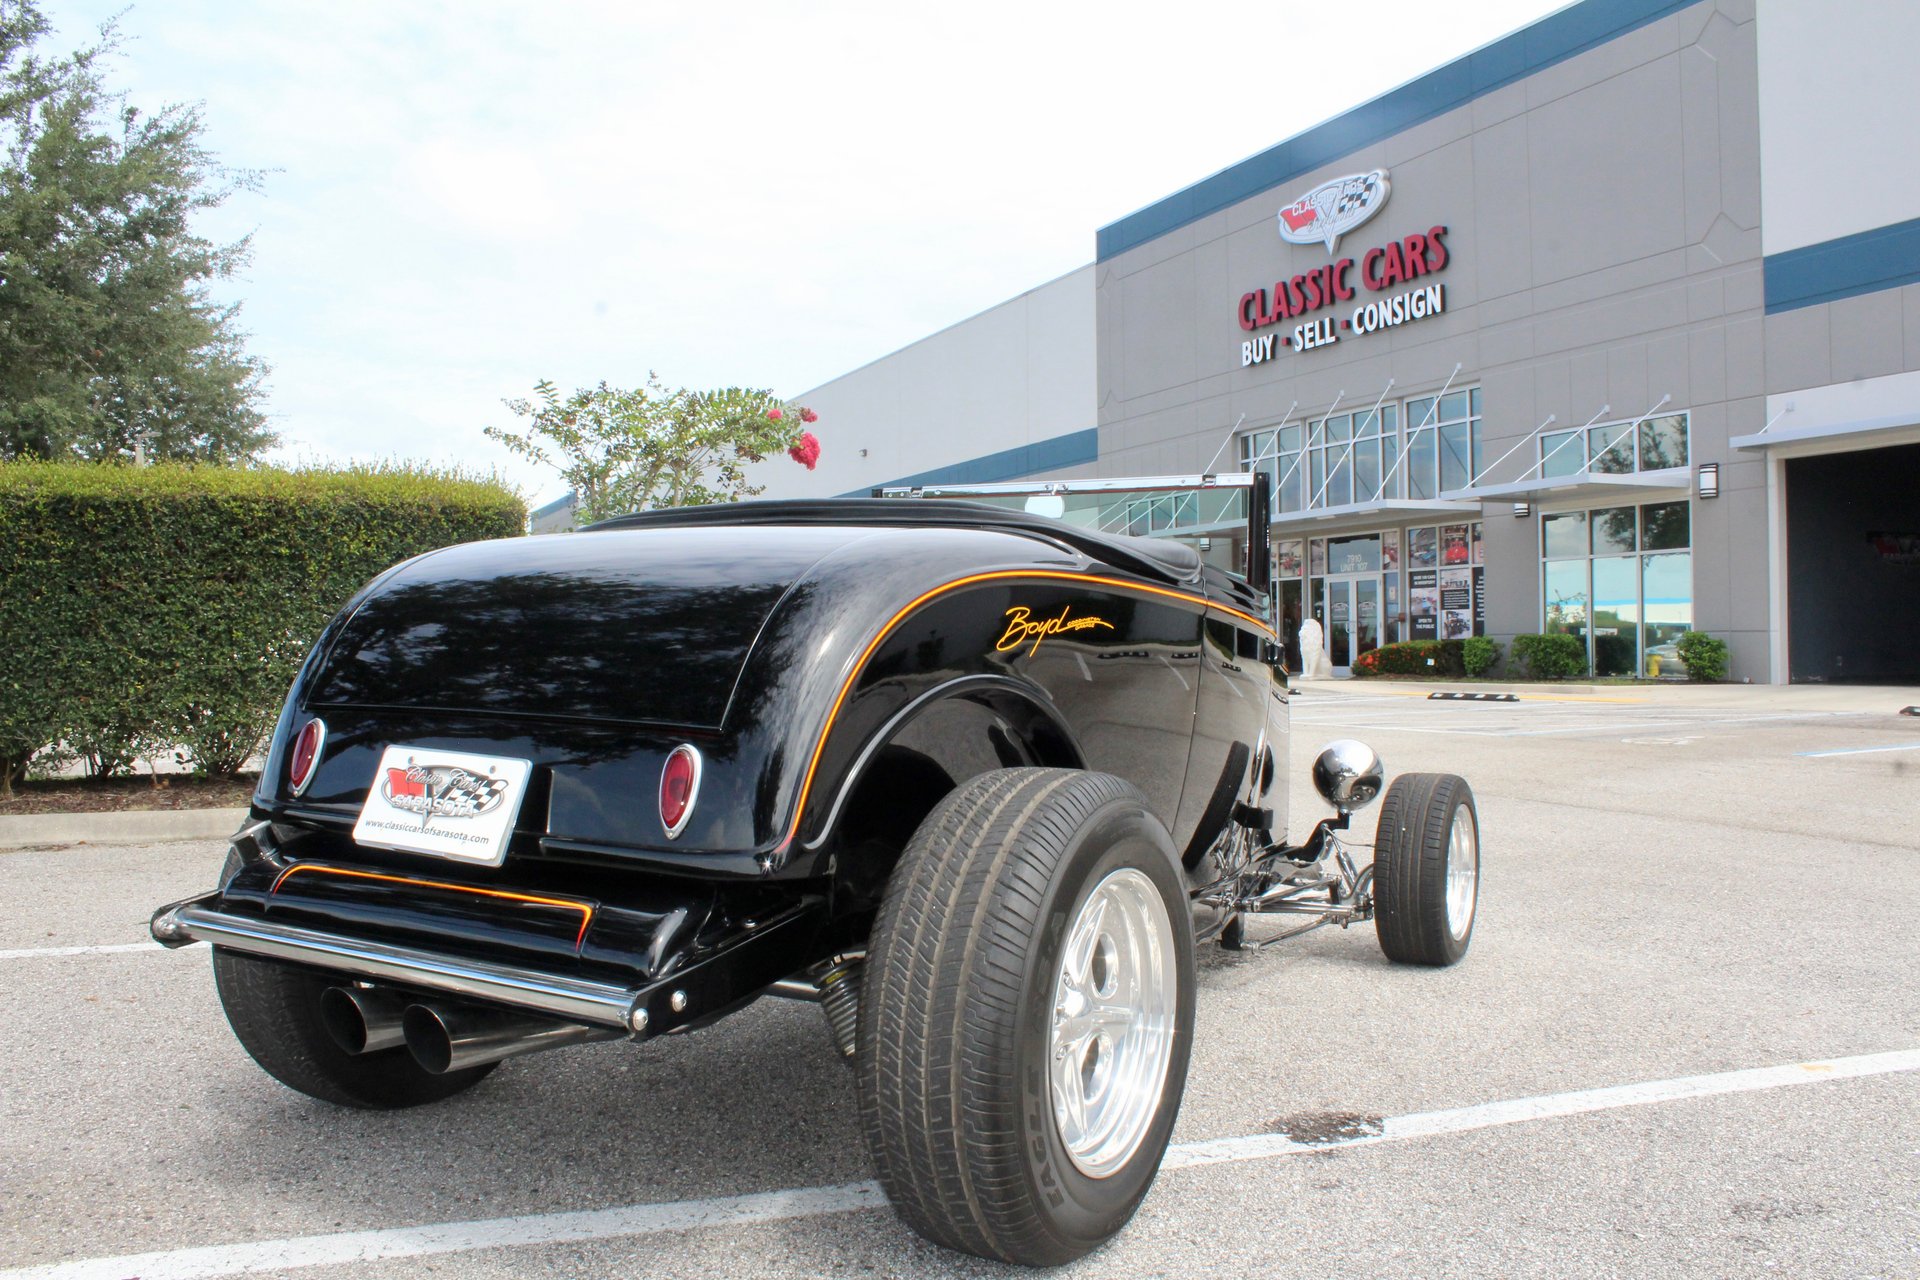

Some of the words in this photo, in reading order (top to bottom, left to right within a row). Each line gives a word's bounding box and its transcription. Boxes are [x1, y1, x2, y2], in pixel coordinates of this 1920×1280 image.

[1238, 258, 1354, 331] CLASSIC
[1361, 225, 1448, 291] CARS
[1241, 333, 1275, 367] BUY
[1294, 317, 1337, 352] SELL
[1352, 284, 1443, 336] CONSIGN
[996, 605, 1085, 658] Boyd
[405, 764, 443, 785] Classic
[449, 768, 485, 791] Cars
[365, 818, 489, 845] www.classiccarsofsarasota.com
[392, 794, 475, 819] SARASOTA
[1028, 1064, 1065, 1209] EAGLE
